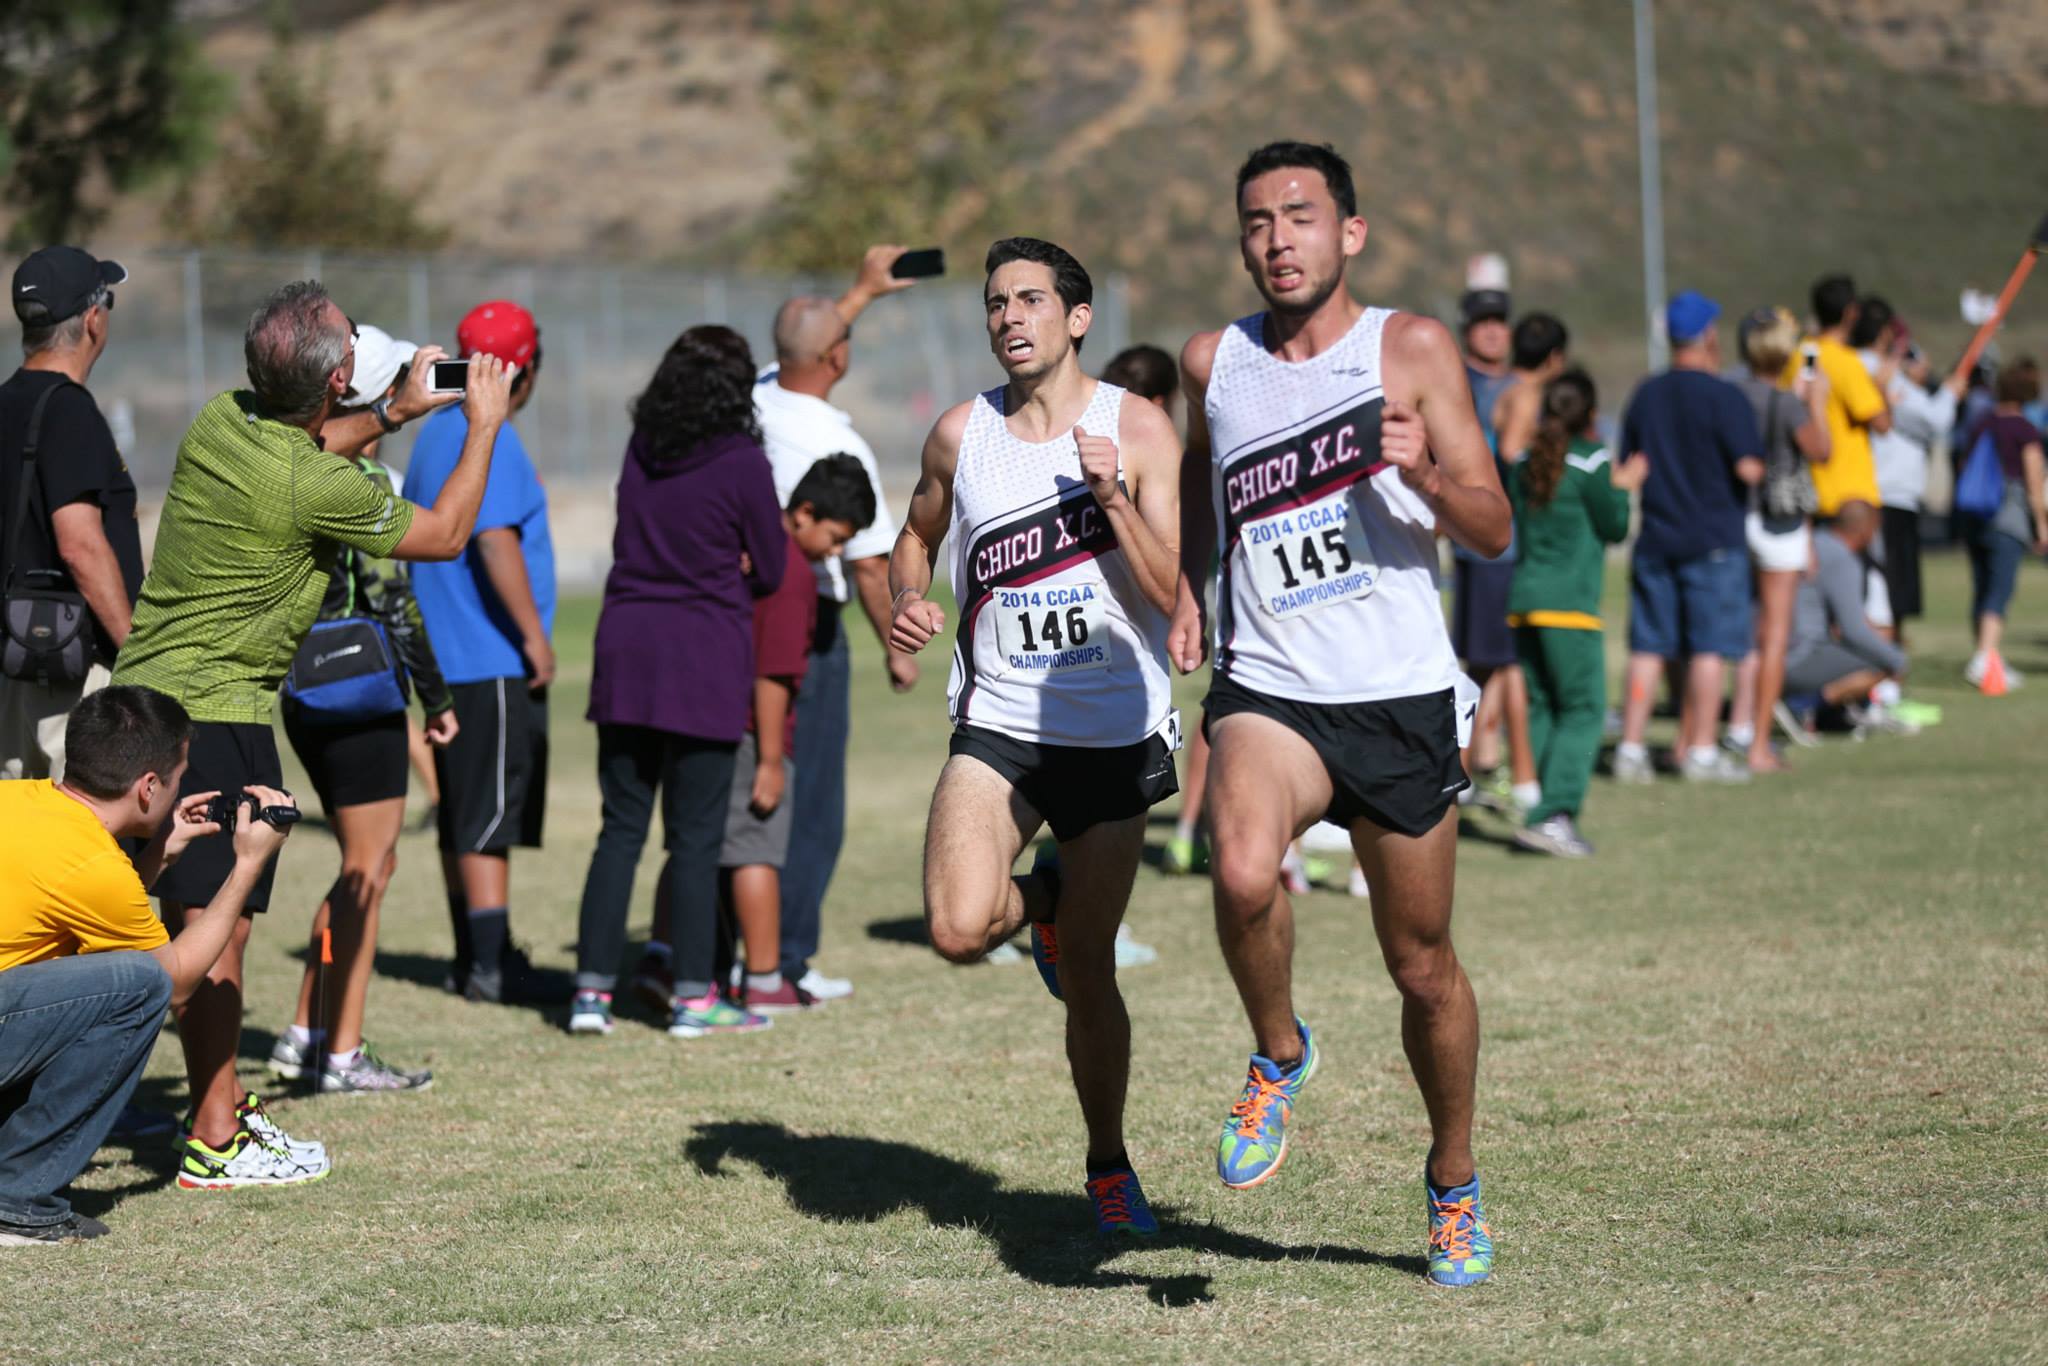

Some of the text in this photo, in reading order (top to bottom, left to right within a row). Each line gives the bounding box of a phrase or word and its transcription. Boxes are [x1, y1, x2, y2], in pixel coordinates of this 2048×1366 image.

[1227, 425, 1361, 514] CHICO X.C.
[976, 505, 1102, 582] CHICO X.C.
[1250, 503, 1348, 545] 2014 CCAA
[1273, 527, 1351, 589] 145
[1000, 585, 1094, 608] 2014 CCAA
[1271, 571, 1373, 614] CHAMPIONSHIPS
[1018, 606, 1088, 651] 146
[1009, 646, 1104, 669] CHAMPIONSHIPS
